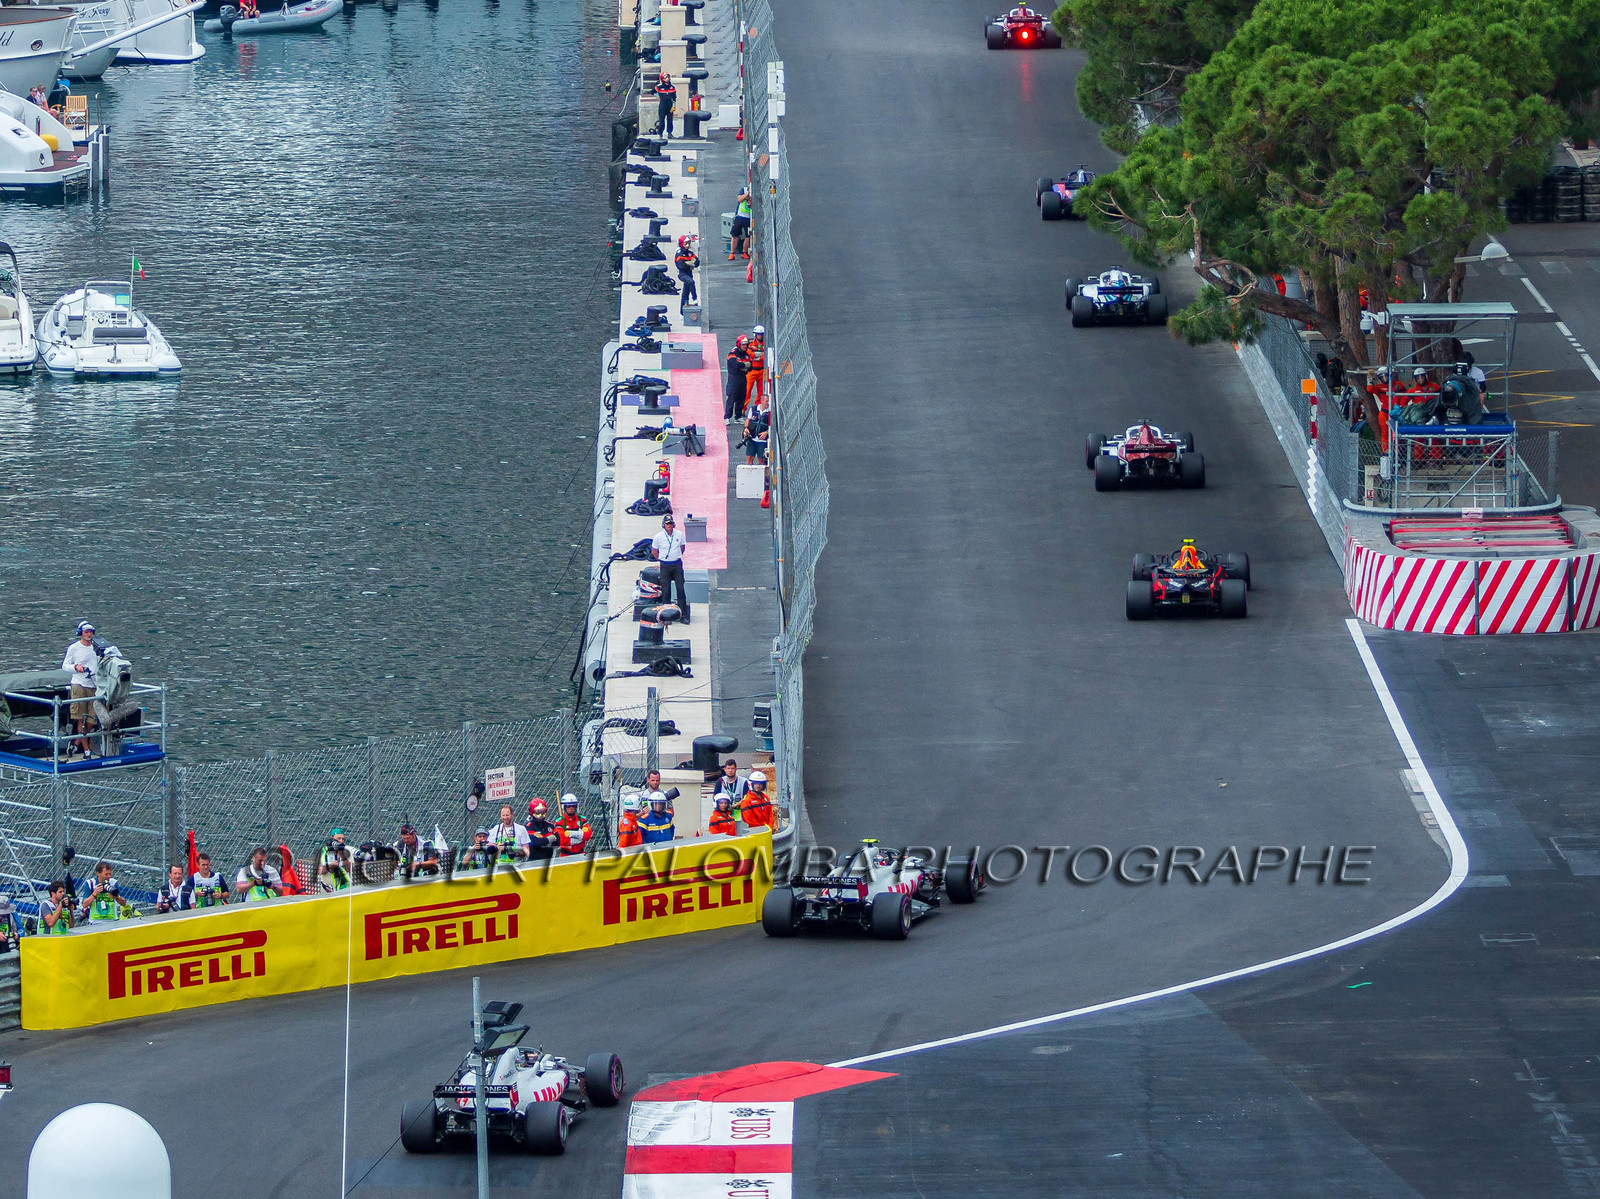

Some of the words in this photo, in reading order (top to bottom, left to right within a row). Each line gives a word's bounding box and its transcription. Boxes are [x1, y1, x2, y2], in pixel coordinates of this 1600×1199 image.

[603, 858, 755, 926] PIRELLI
[363, 892, 521, 961] PIRELLI
[107, 929, 268, 1000] PIRELLI
[730, 1118, 771, 1140] UBS
